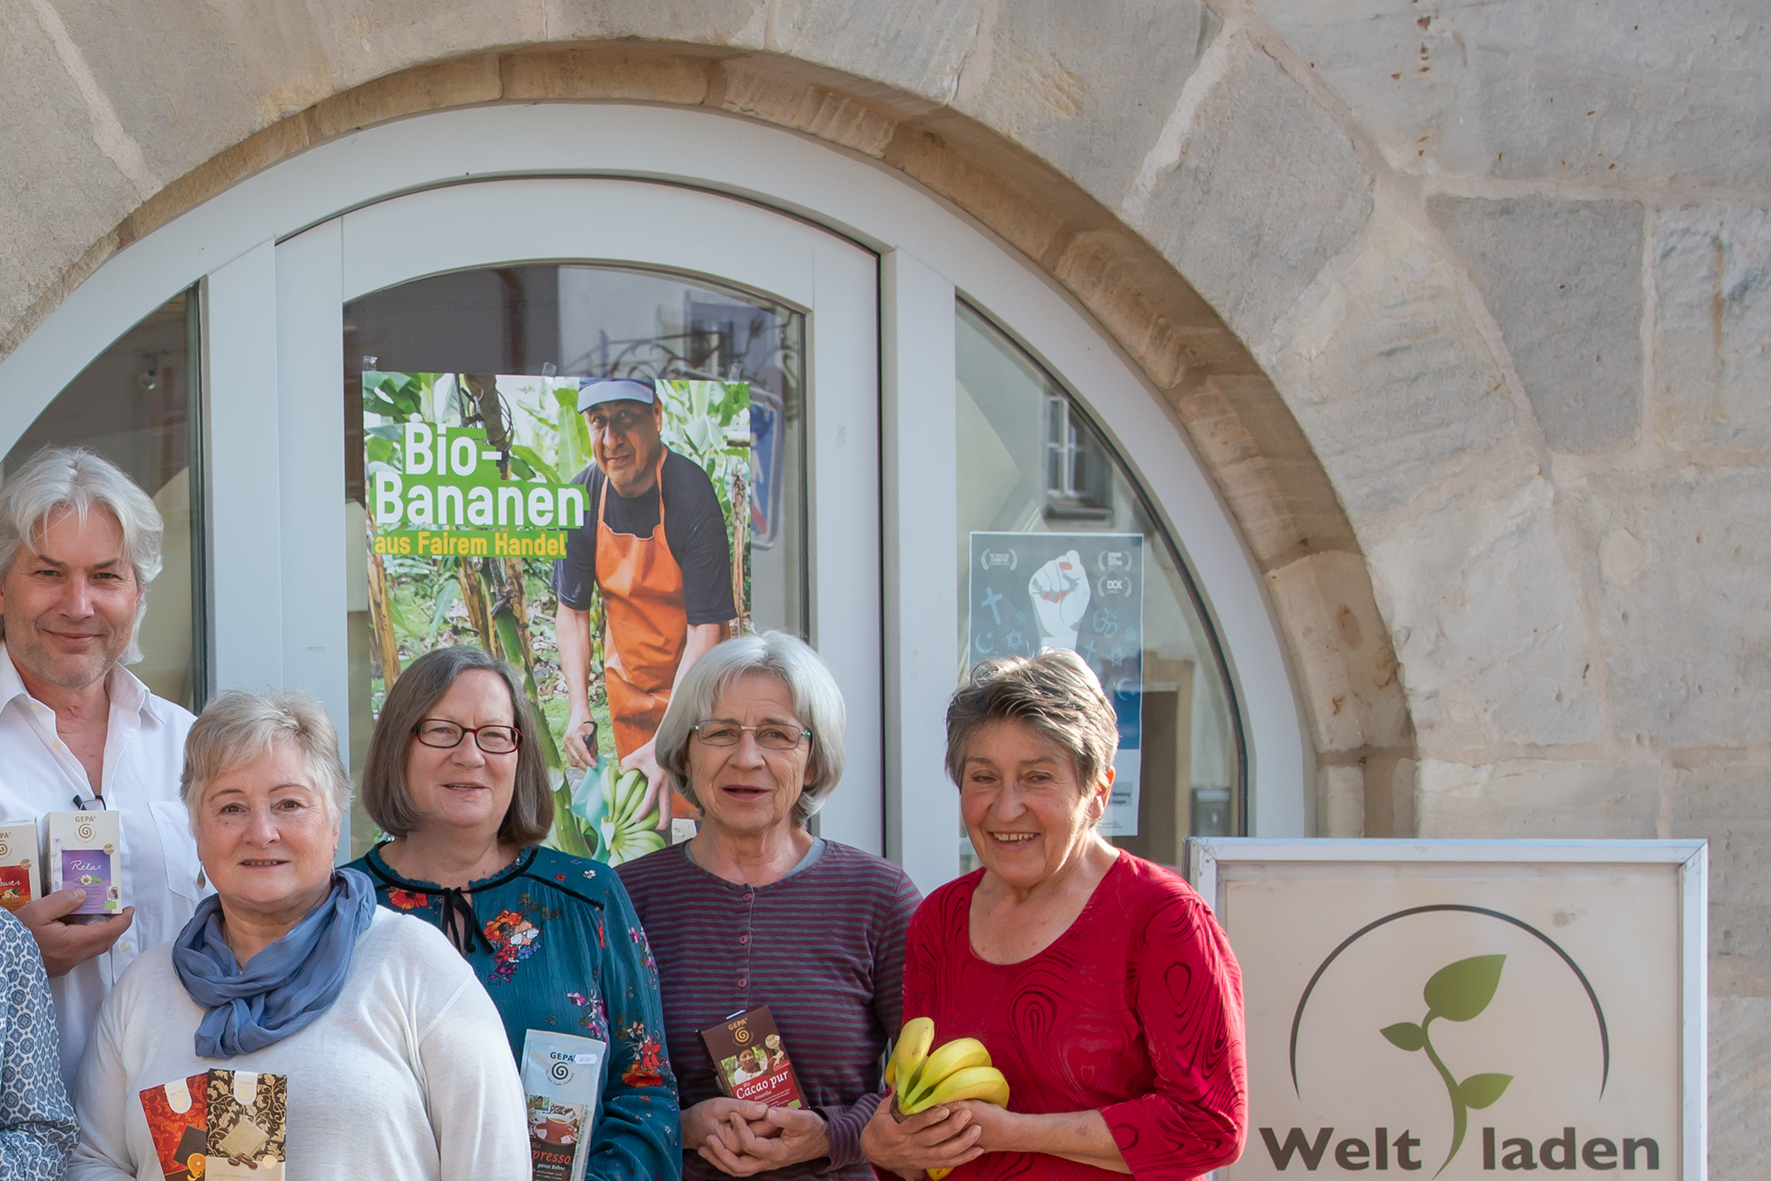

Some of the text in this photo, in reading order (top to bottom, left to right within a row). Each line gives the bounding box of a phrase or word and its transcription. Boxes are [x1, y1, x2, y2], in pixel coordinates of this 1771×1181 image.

[405, 423, 502, 476] Bio-
[376, 471, 584, 526] Bananen
[375, 532, 566, 556] aus Fairem Handel
[70, 860, 102, 871] Relax
[549, 1051, 574, 1062] GEPA
[736, 1080, 768, 1100] Cacao
[769, 1071, 788, 1089] pur
[532, 1149, 572, 1165] presso
[1259, 1126, 1660, 1171] Welt laden
